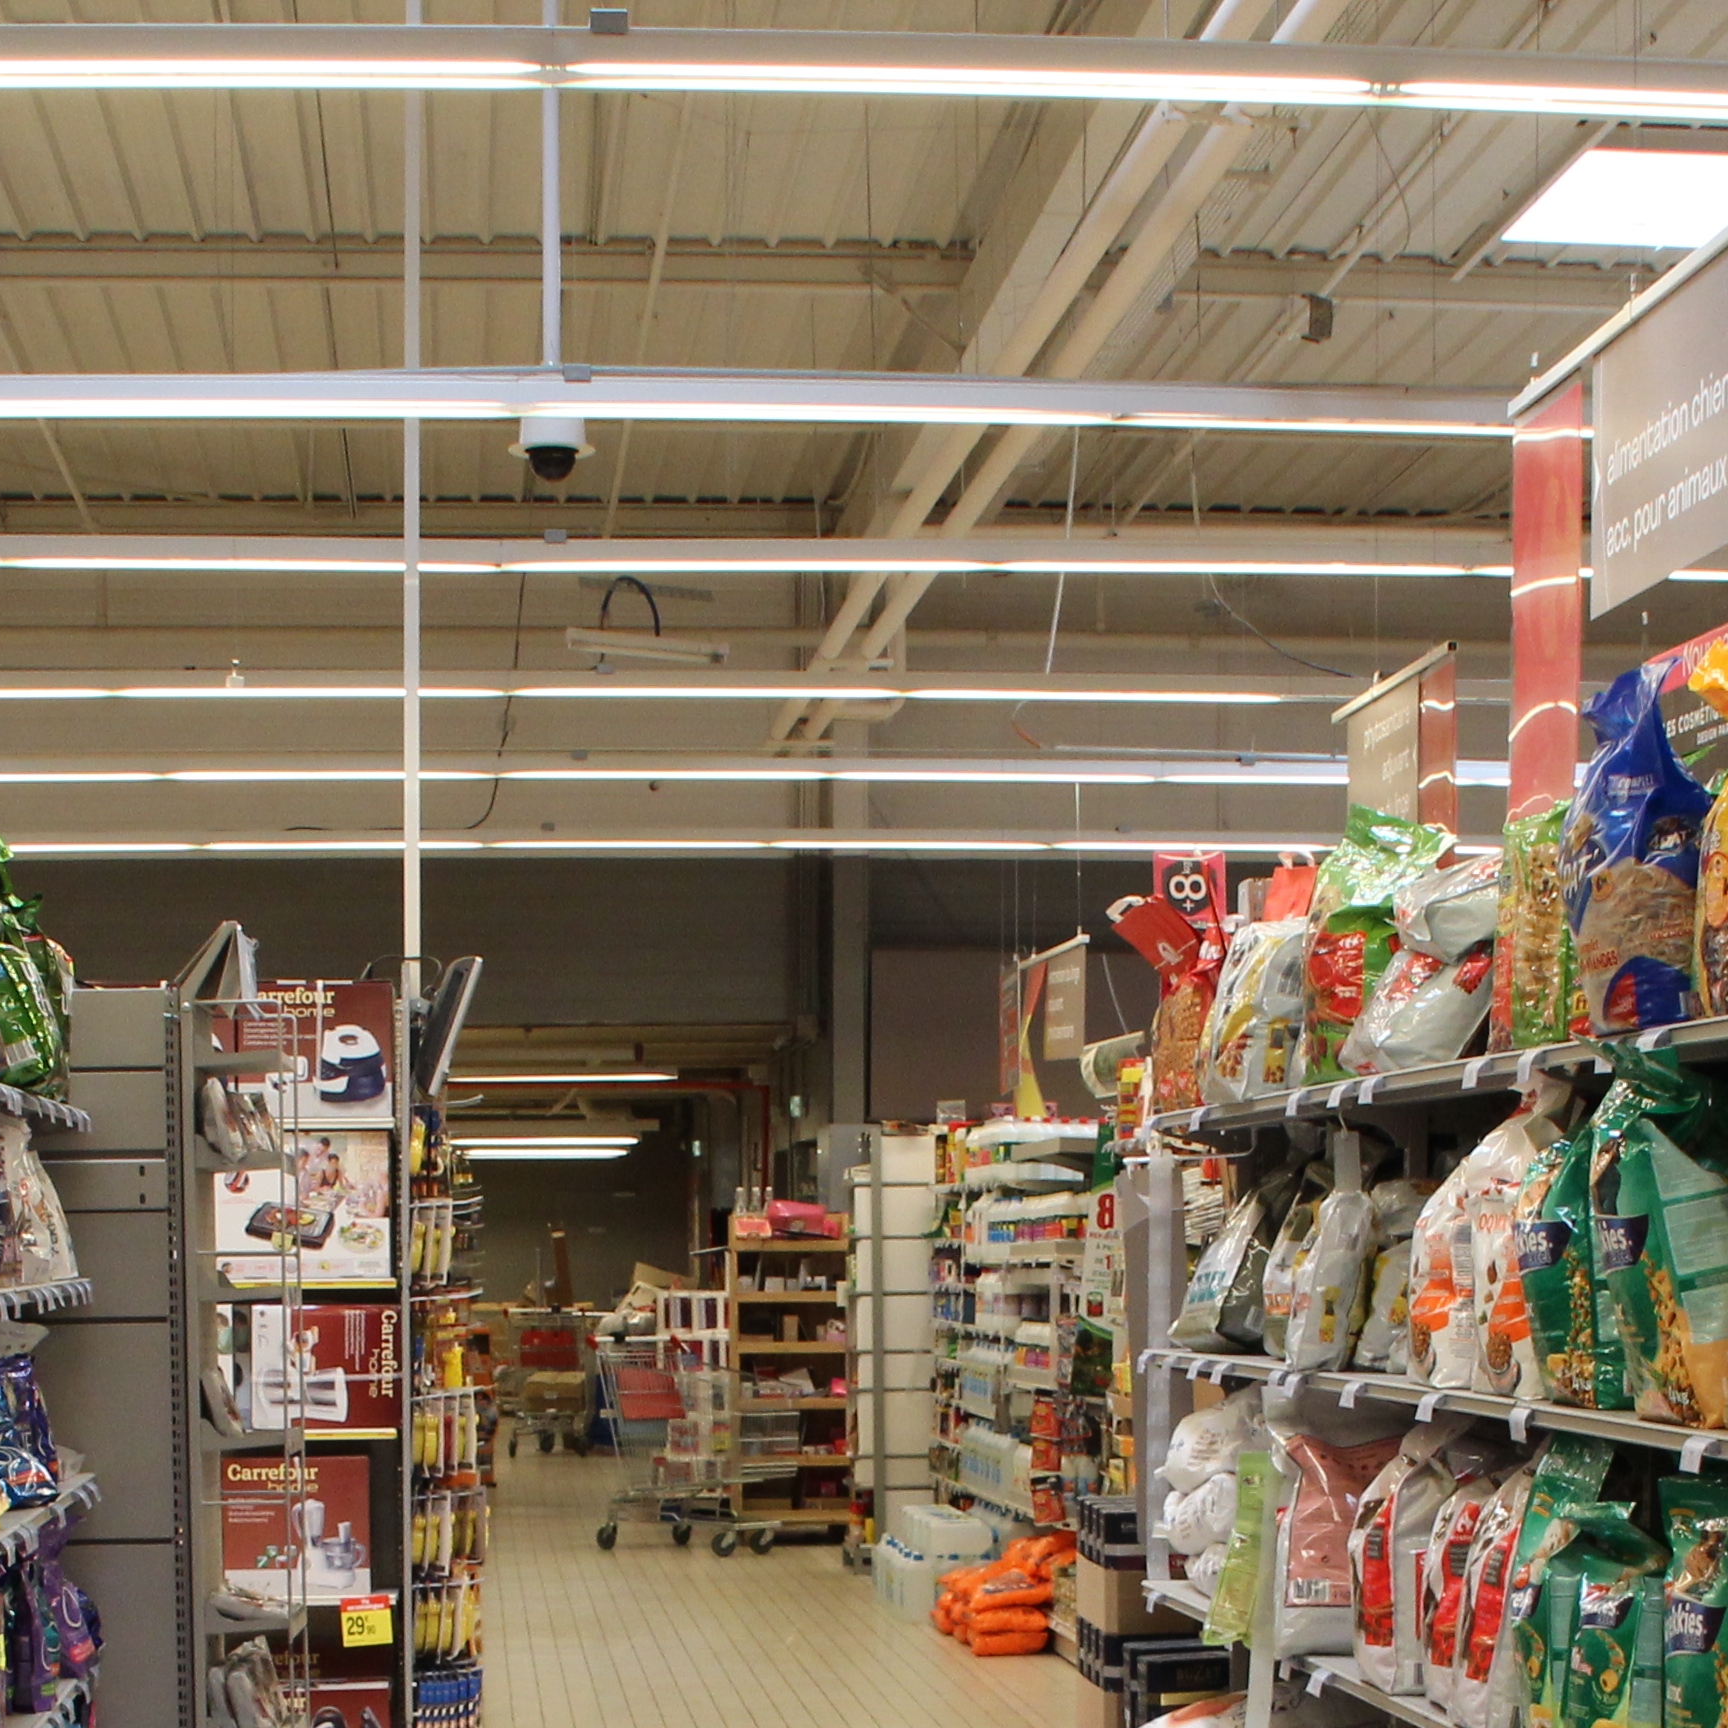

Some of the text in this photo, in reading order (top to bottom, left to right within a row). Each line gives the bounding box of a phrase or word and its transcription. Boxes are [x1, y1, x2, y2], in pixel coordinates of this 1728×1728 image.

[1606, 400, 1692, 485] alimentation
[1605, 453, 1728, 556] acc. pour animaux
[257, 986, 336, 1006] arrefour
[282, 1005, 336, 1019] home
[380, 1308, 399, 1400] Carrefour
[226, 1462, 320, 1483] Carrefour
